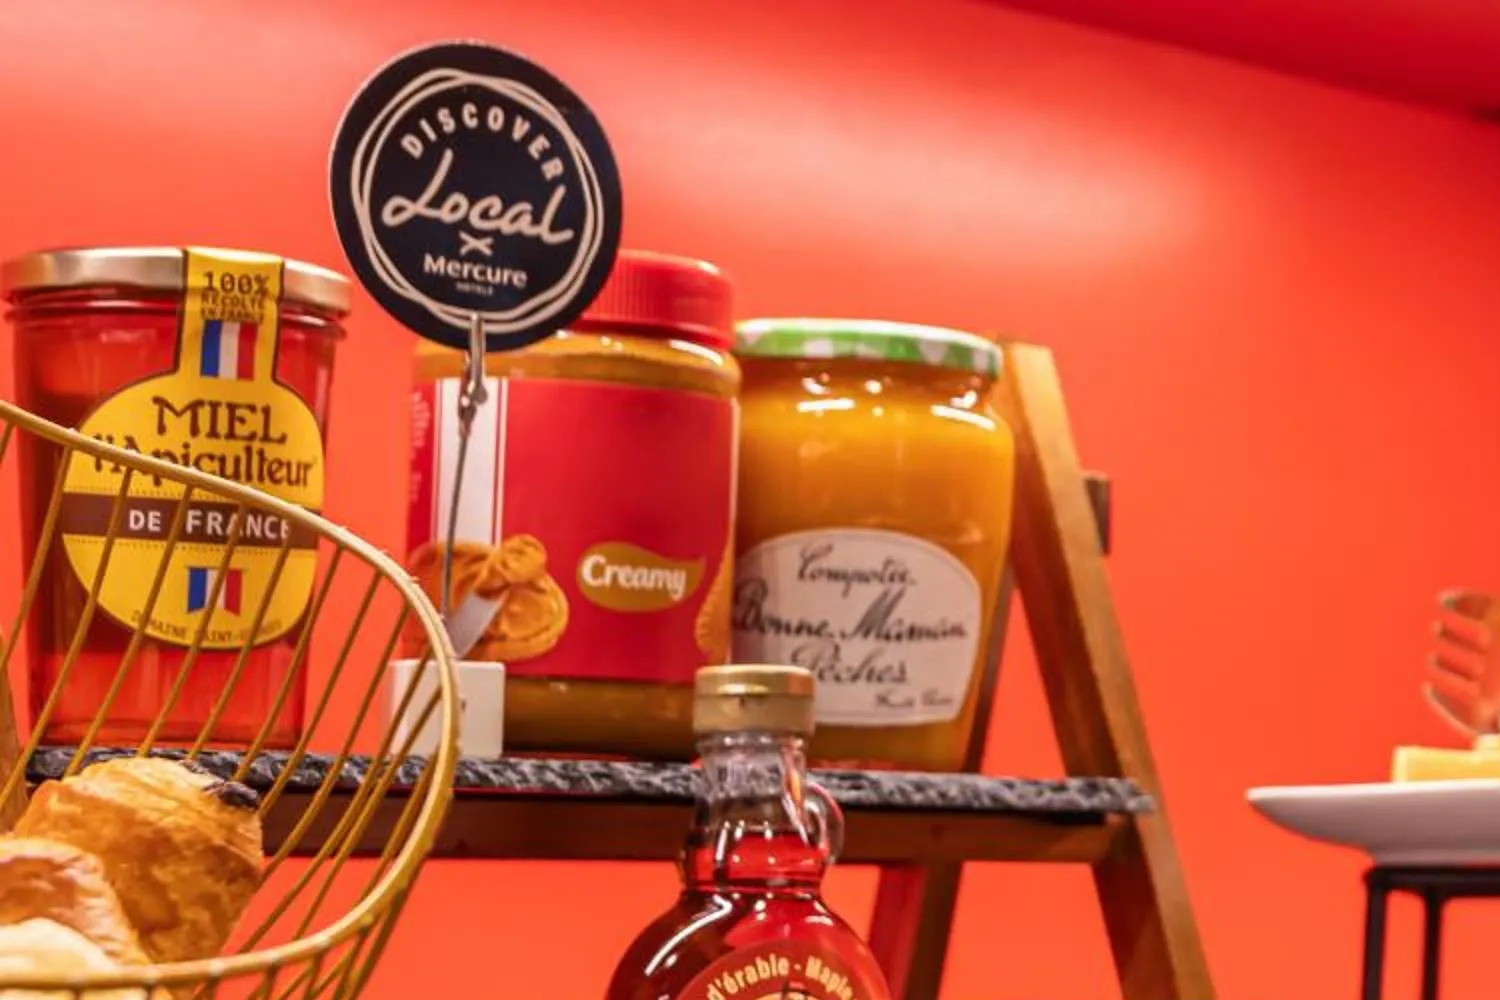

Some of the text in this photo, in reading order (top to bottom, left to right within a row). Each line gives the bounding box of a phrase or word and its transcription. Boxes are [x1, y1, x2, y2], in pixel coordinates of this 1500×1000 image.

[400, 102, 566, 181] DISCOVER
[381, 148, 574, 245] Local
[203, 270, 271, 298] 100%
[424, 252, 528, 288] Mercure
[152, 396, 288, 444] MIEL
[128, 509, 162, 533] DE
[581, 554, 687, 601] Creamy
[734, 577, 968, 642] Bonne Maman
